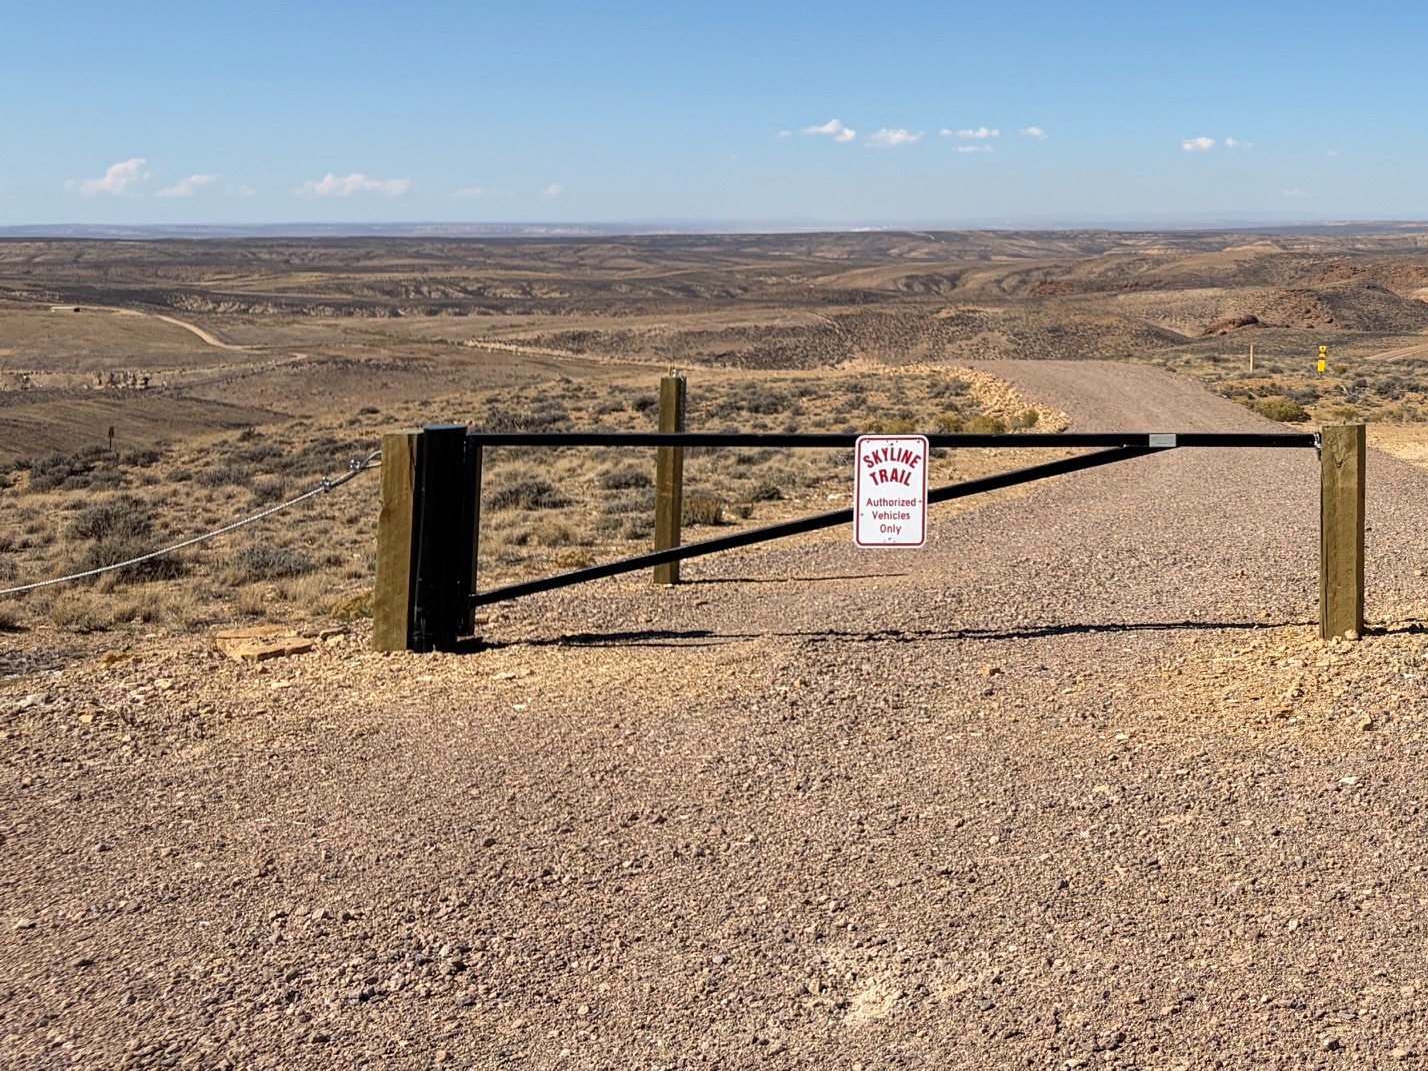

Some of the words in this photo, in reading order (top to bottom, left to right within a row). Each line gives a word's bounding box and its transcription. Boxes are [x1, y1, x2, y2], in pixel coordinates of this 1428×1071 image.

[863, 447, 921, 468] SKYLINE
[869, 468, 912, 486] TRAIL
[866, 498, 916, 507] Authorized
[872, 511, 910, 520] Vehicles
[880, 524, 902, 535] Only
